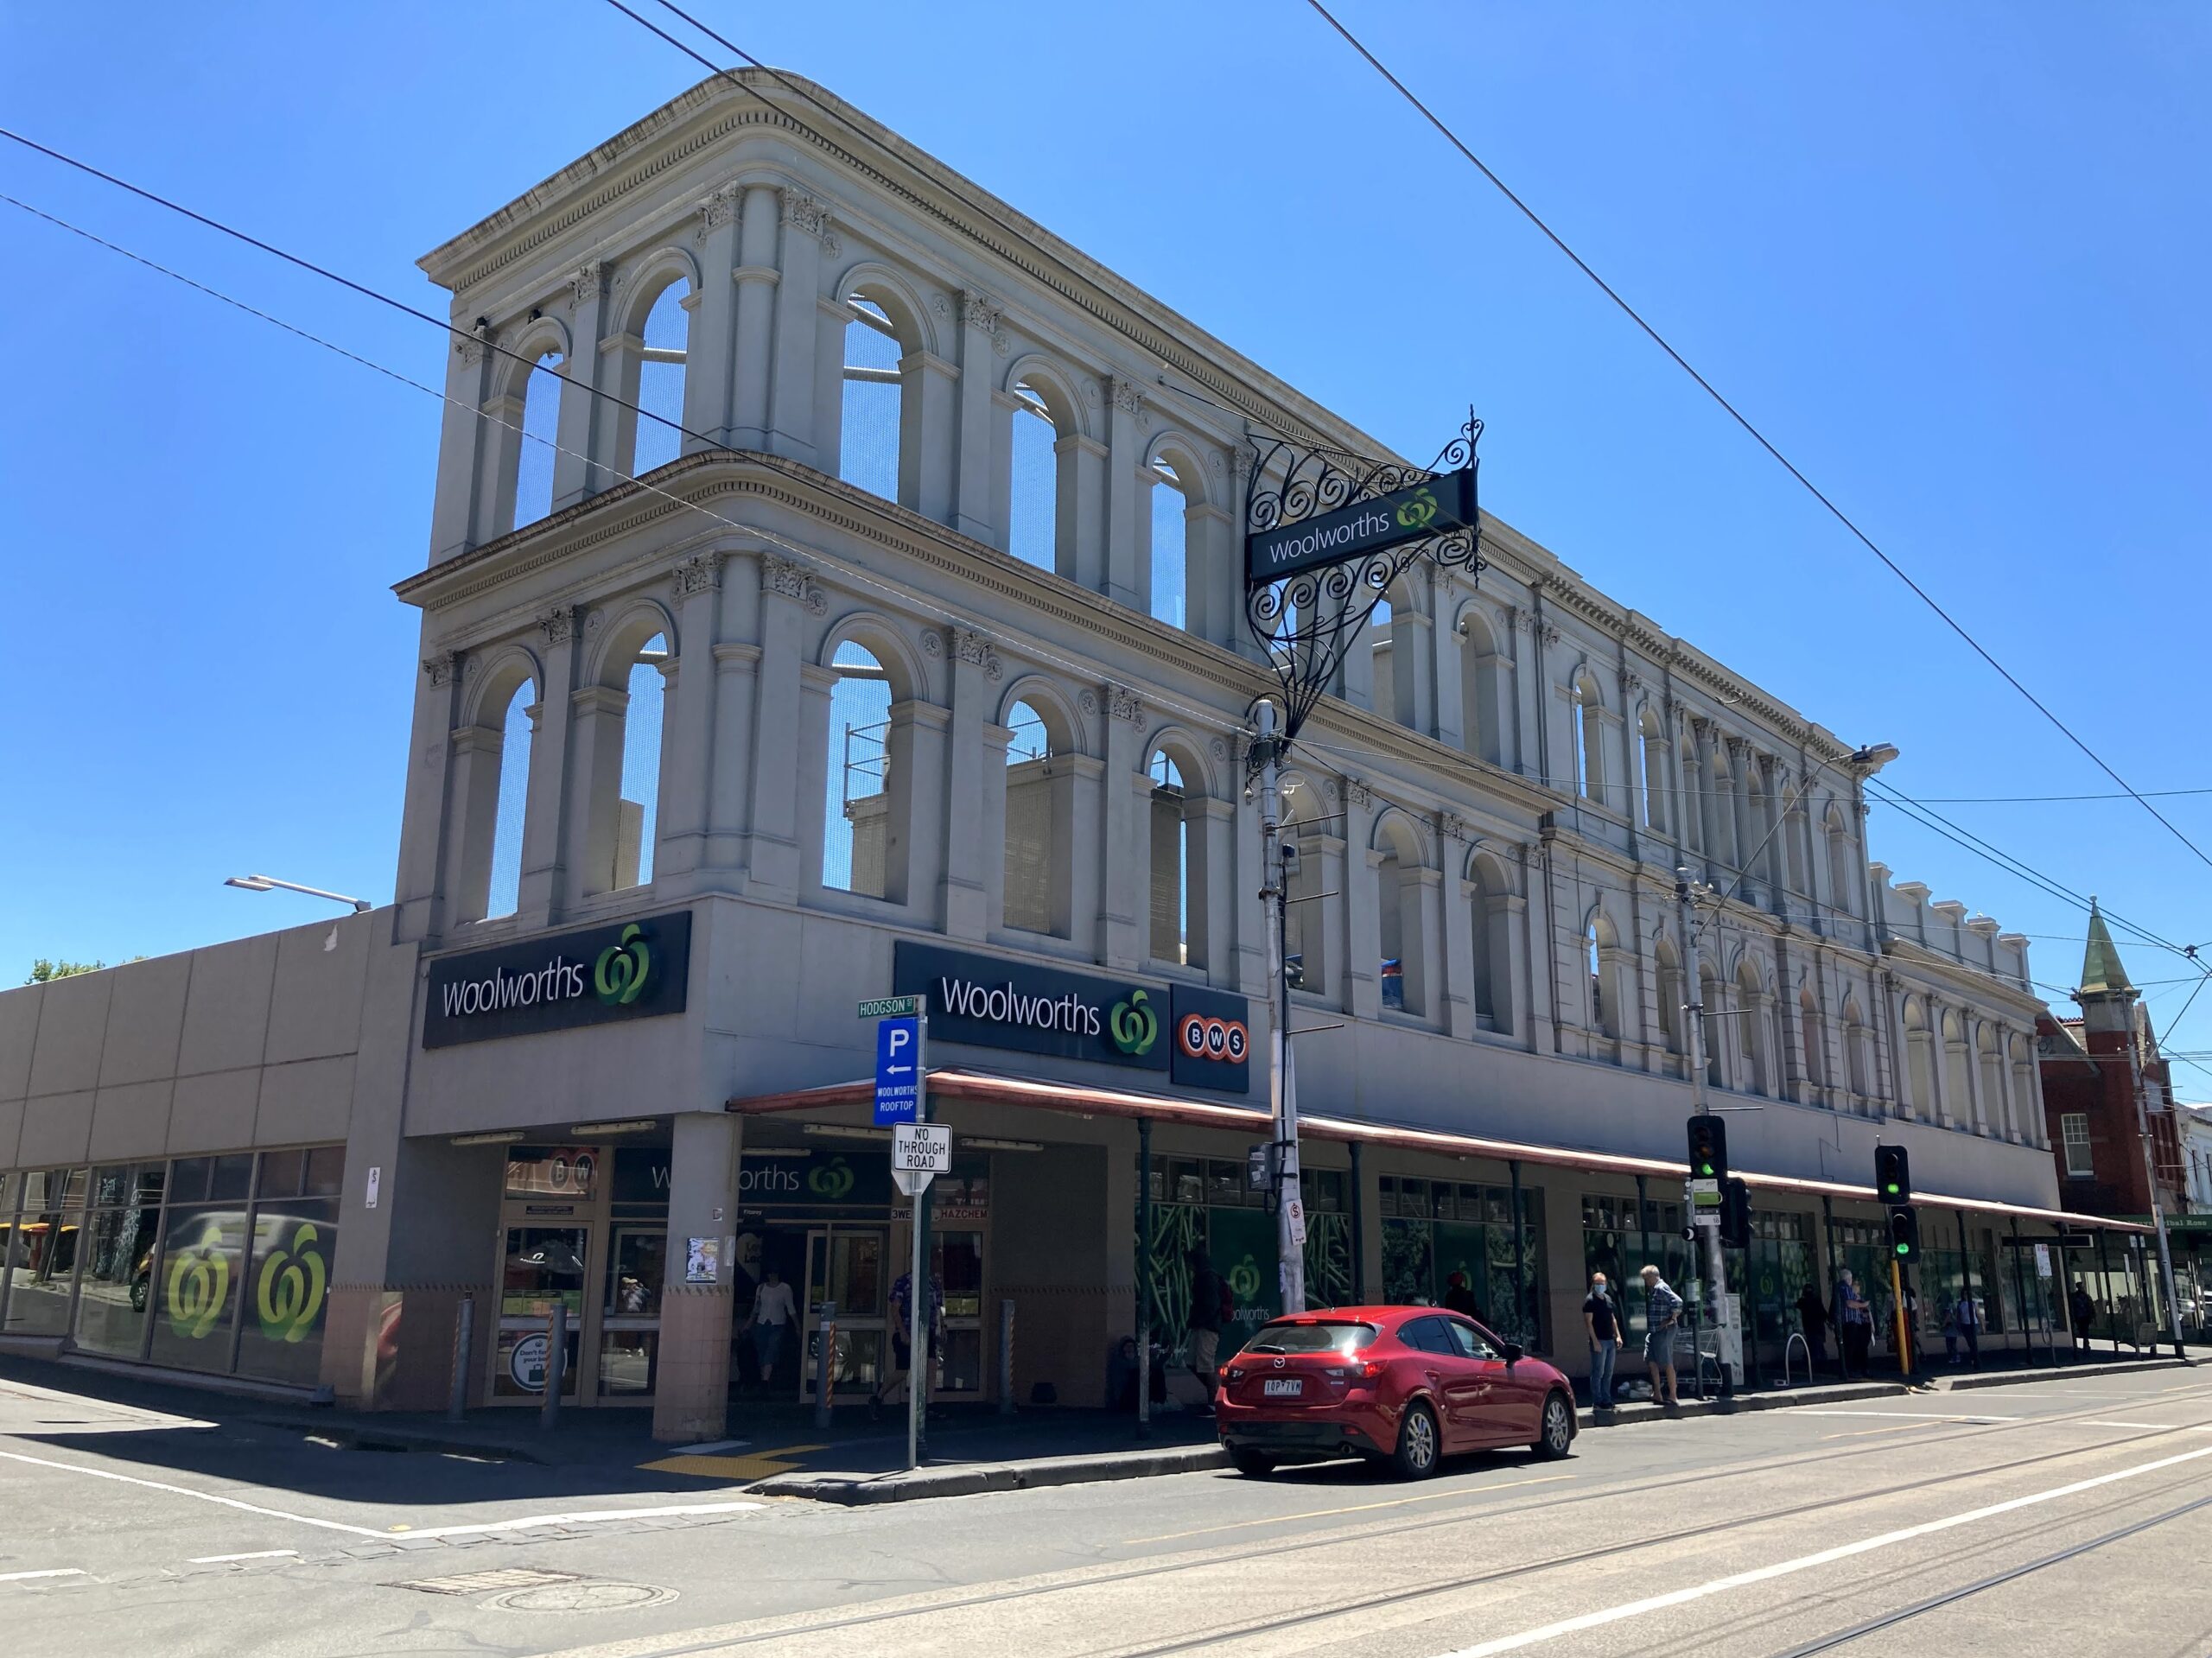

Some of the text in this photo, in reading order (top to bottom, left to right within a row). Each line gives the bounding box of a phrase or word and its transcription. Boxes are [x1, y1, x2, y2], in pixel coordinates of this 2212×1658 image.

[1270, 511, 1389, 563] Woolworths
[443, 955, 585, 1018] Woolworths
[860, 999, 906, 1016] HODGSON
[942, 976, 1101, 1036] Woolworths
[889, 1028, 909, 1058] P
[878, 1085, 918, 1097] WOOLWORTHS
[880, 1101, 913, 1112] ROOFTOP
[914, 1128, 930, 1141] NO
[899, 1140, 945, 1155] THROUGH
[906, 1154, 935, 1168] ROAD
[941, 1210, 988, 1218] HAZCHEM
